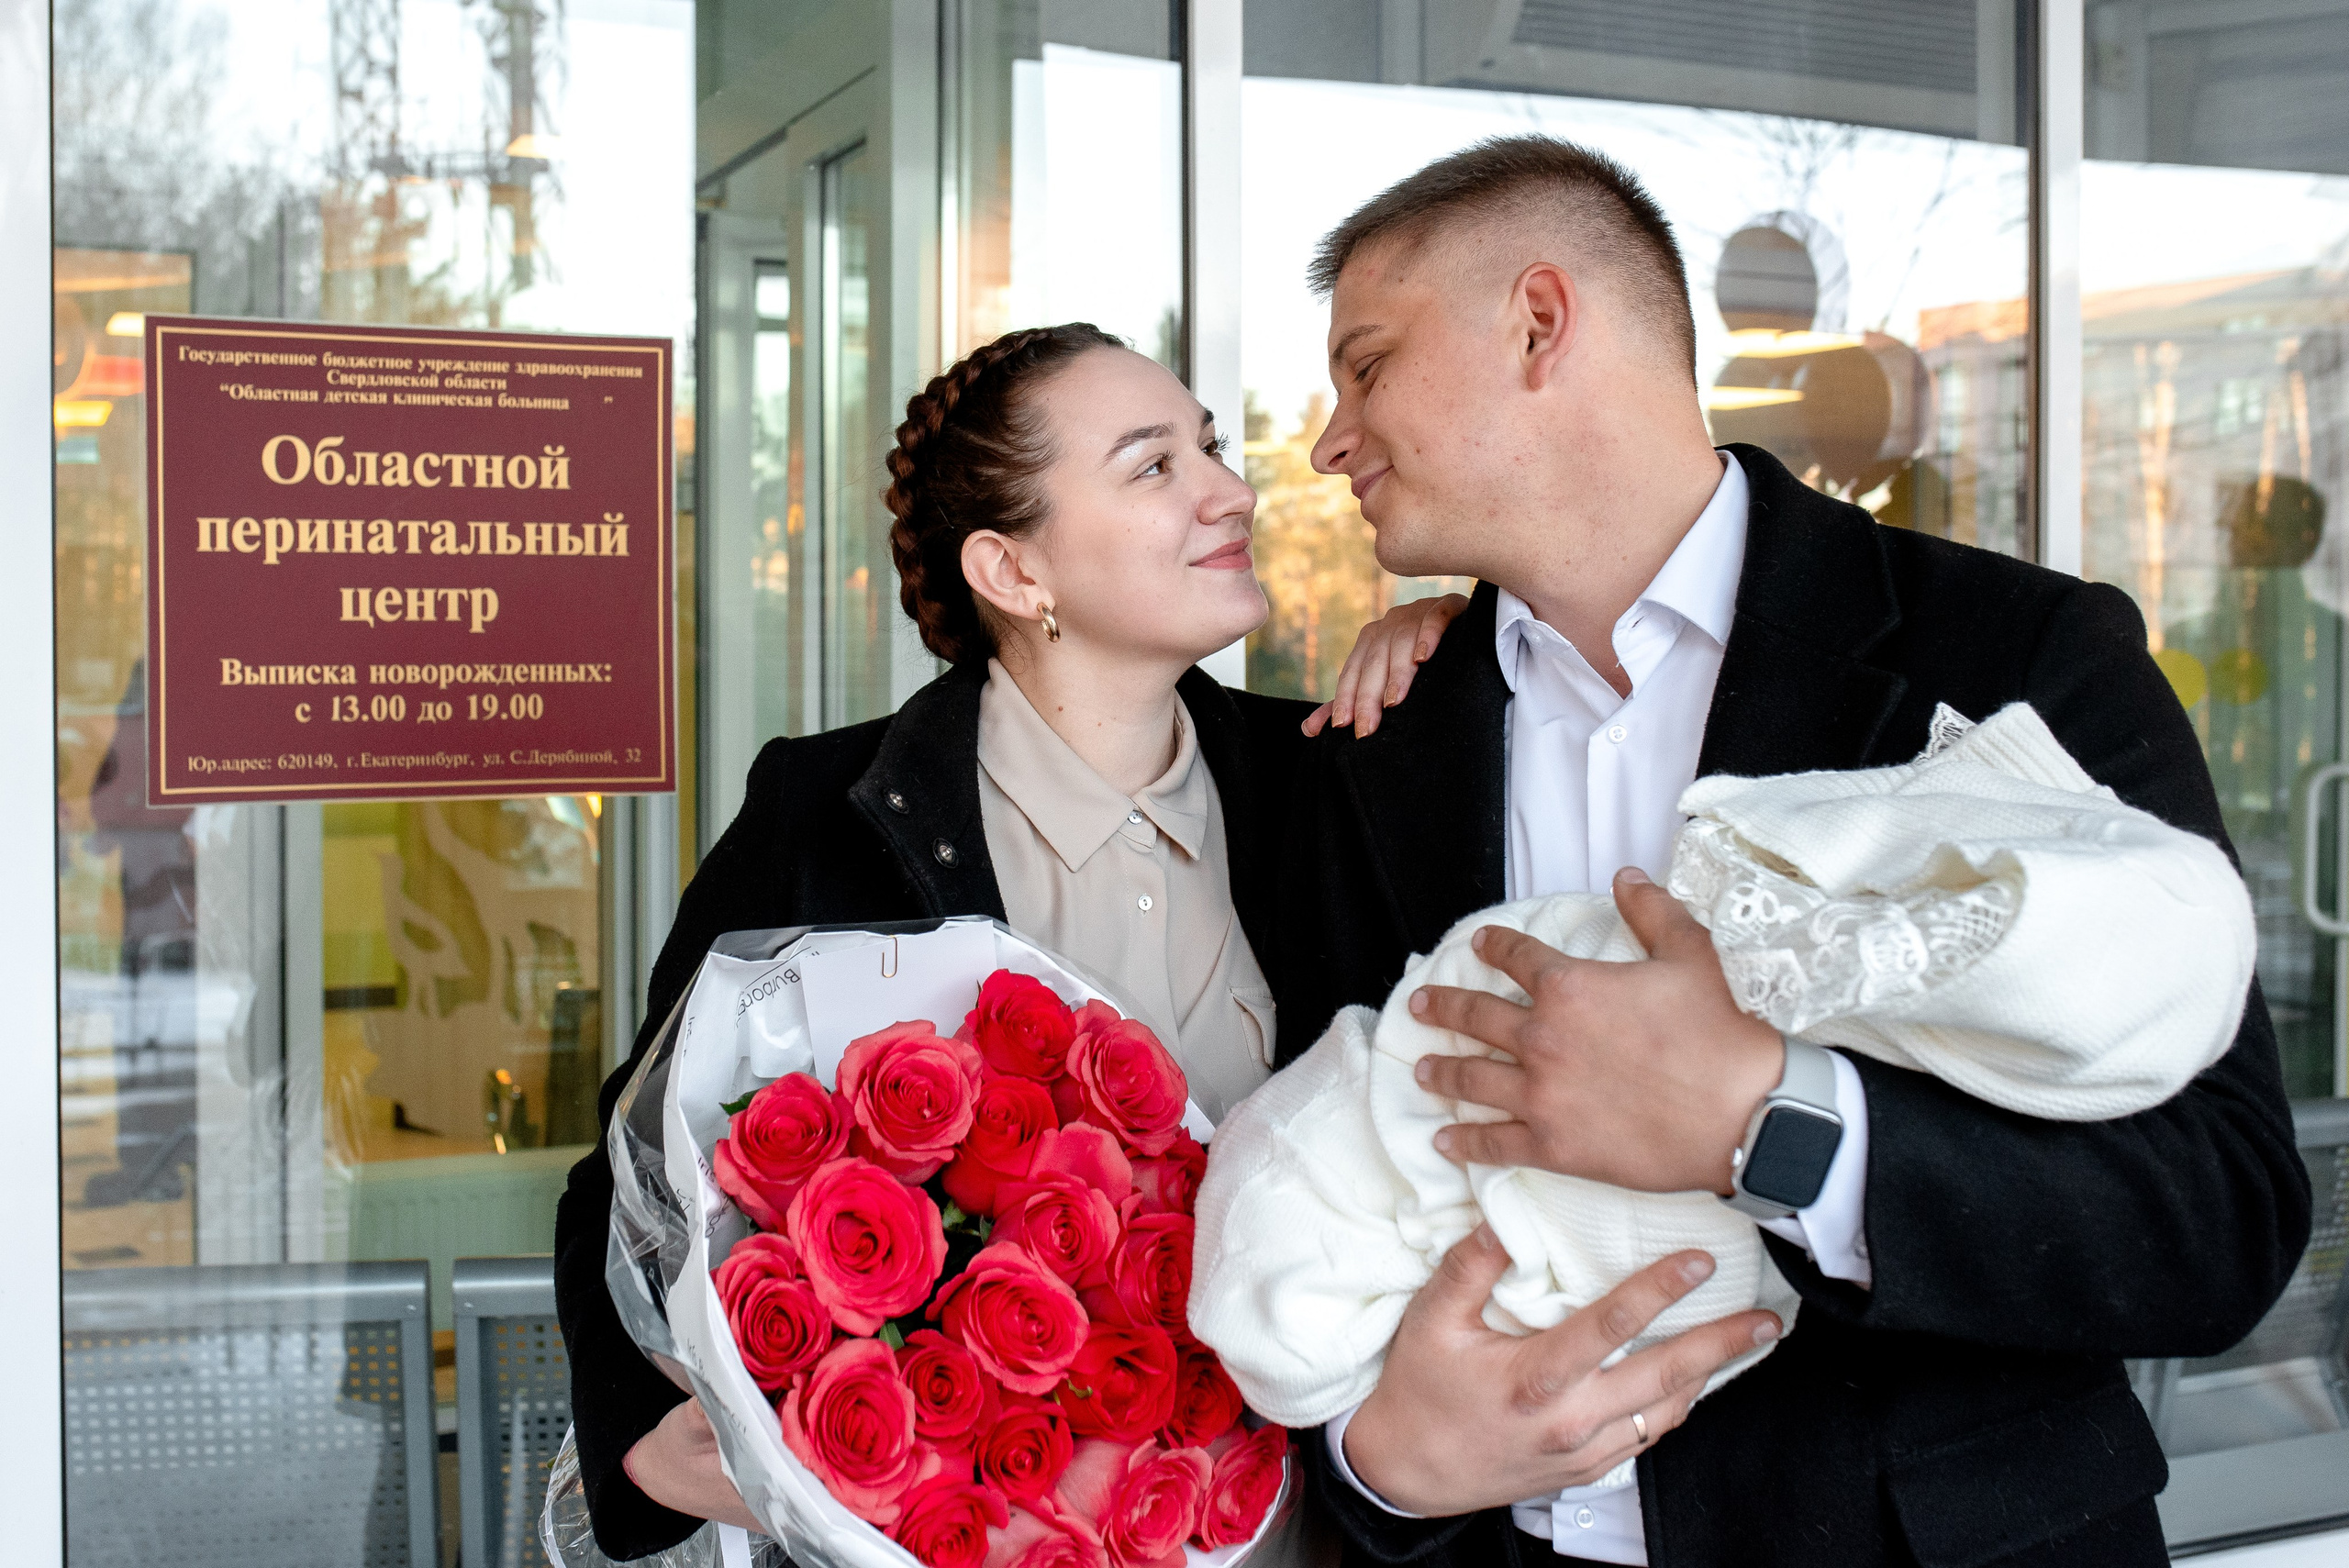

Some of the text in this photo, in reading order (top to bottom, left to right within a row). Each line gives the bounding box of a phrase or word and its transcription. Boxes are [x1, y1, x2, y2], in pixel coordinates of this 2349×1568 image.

[178, 345, 643, 379] Государственное бюджетное учреждение здравоохранения
[326, 369, 507, 390] Свердловской области
[323, 390, 388, 405] детская
[393, 393, 493, 407] клиническая
[497, 392, 570, 411] больница
[261, 434, 571, 490] Областной
[196, 512, 629, 565] перинатальный
[340, 586, 499, 633] центр
[220, 658, 612, 690] Выписка новорожденных:
[295, 693, 544, 724] с 13.00 до 19.00
[187, 755, 272, 774] Юр.адрес:
[483, 753, 506, 768] ул.
[626, 747, 642, 763] 32
